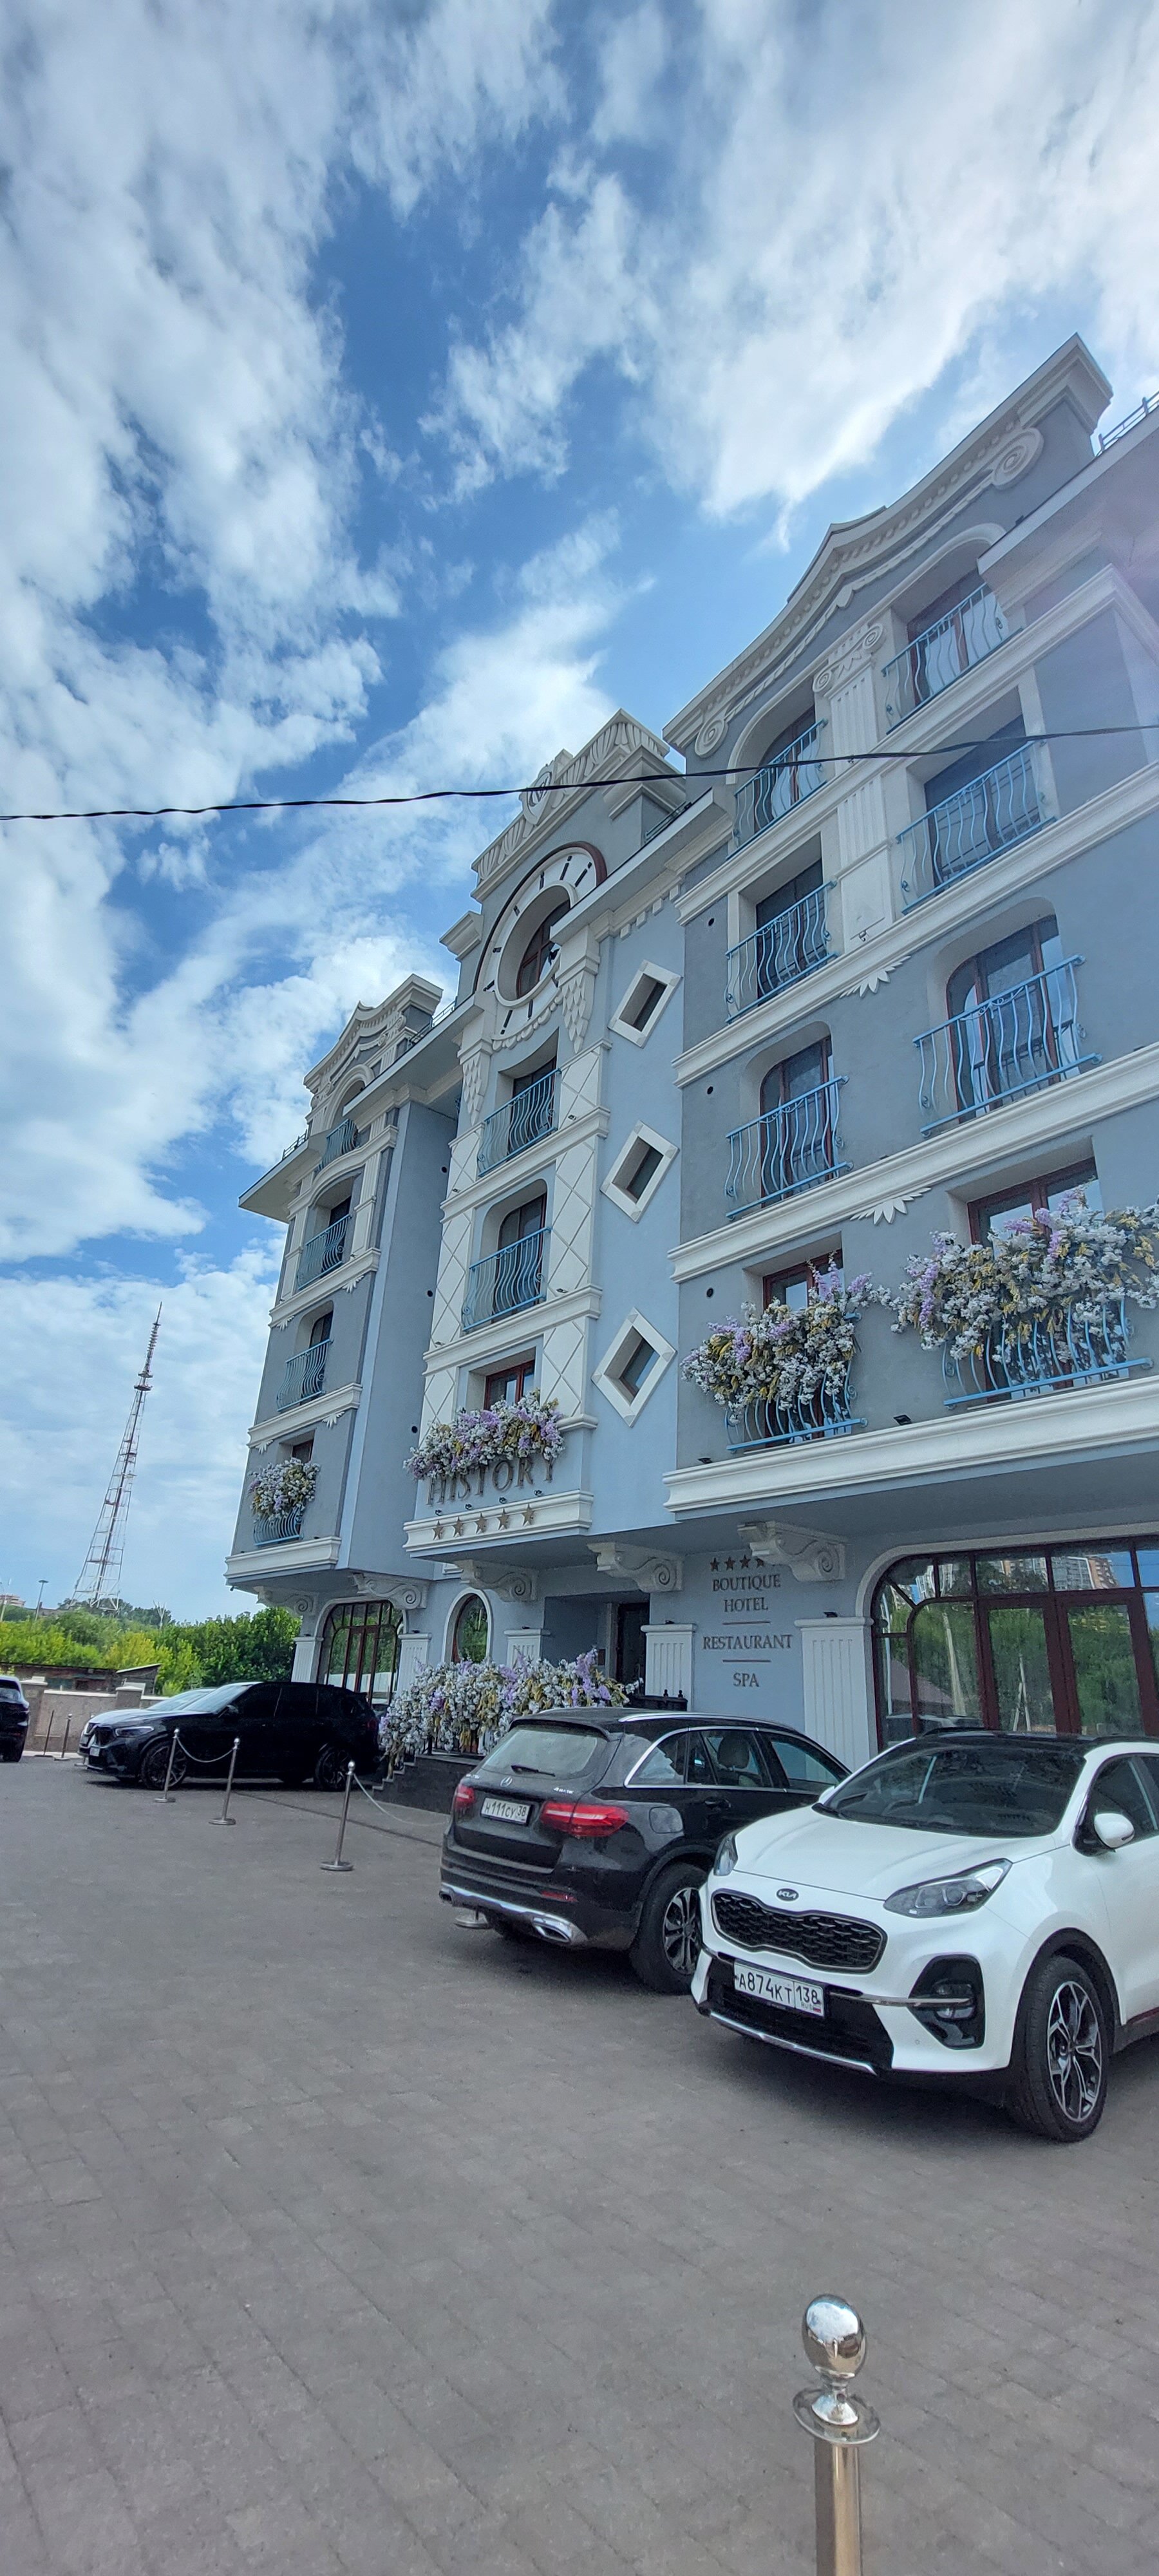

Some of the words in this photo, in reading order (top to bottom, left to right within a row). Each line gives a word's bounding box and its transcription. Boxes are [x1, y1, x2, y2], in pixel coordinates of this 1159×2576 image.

[712, 1574, 781, 1592] BOUTIQUE
[724, 1596, 769, 1613] HOTEL
[702, 1634, 793, 1650] RESTAURANT
[733, 1672, 760, 1687] SPA
[778, 1890, 797, 1899] KIA
